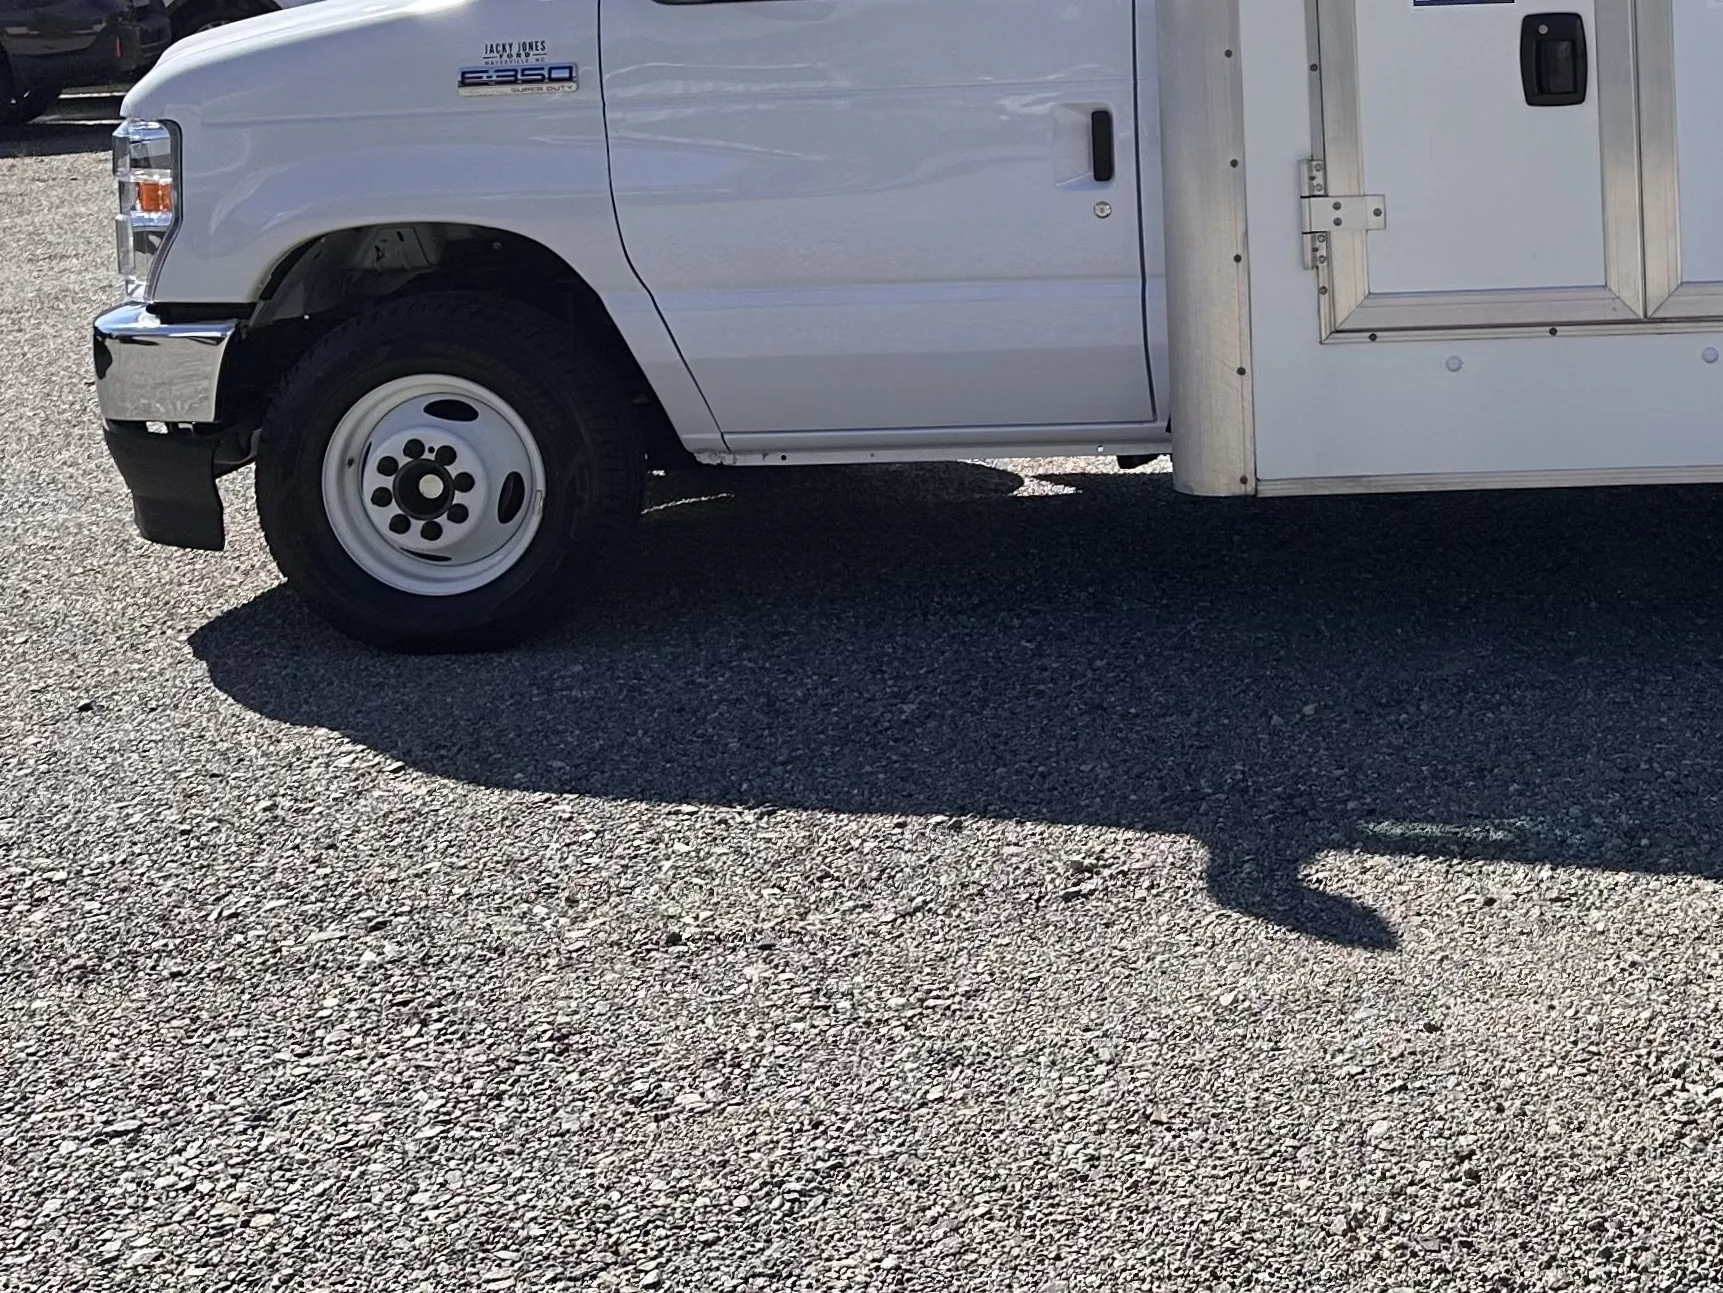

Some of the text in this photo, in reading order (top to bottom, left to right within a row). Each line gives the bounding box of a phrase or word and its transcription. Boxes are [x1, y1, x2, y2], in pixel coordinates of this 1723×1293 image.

[484, 40, 546, 55] JACKY JONES
[510, 84, 574, 94] SUPER DUTY
